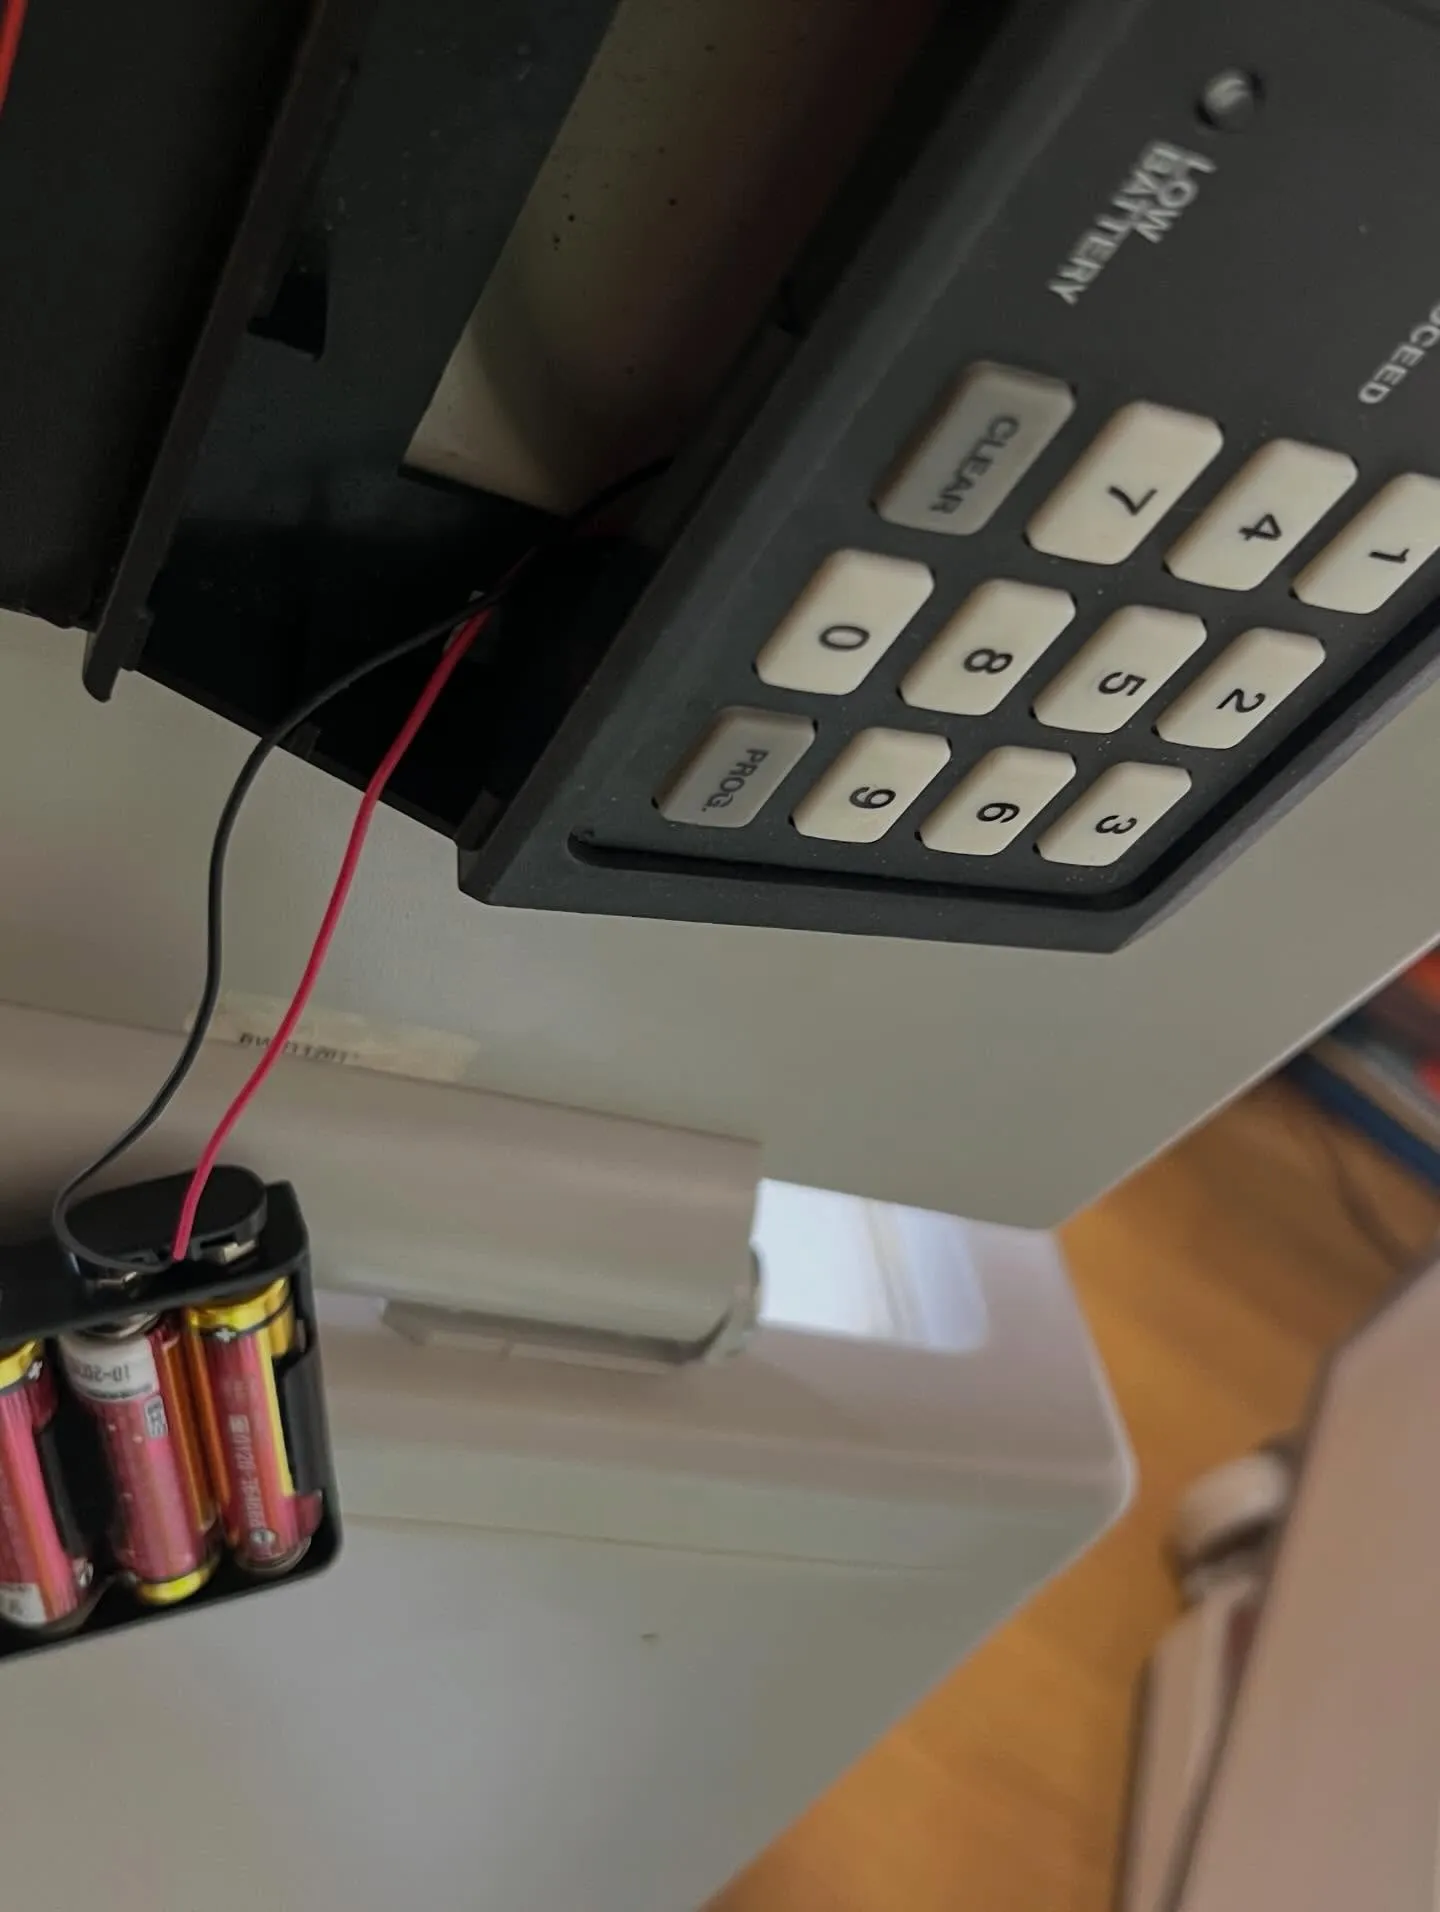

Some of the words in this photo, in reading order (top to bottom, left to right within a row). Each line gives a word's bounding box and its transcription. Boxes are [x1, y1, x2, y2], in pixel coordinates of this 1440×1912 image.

[1137, 156, 1216, 243] LOW
[930, 415, 1018, 515] CLEAR
[1108, 485, 1157, 517] 7
[1239, 513, 1282, 542] 4
[1368, 547, 1410, 565] 1
[819, 624, 870, 652] 0
[963, 648, 1014, 676] 8
[1098, 671, 1144, 697] 5
[1216, 688, 1266, 714] 2
[700, 747, 769, 812] PROG.
[849, 786, 896, 810] 9
[976, 801, 1020, 824] 6
[1094, 813, 1137, 835] 3
